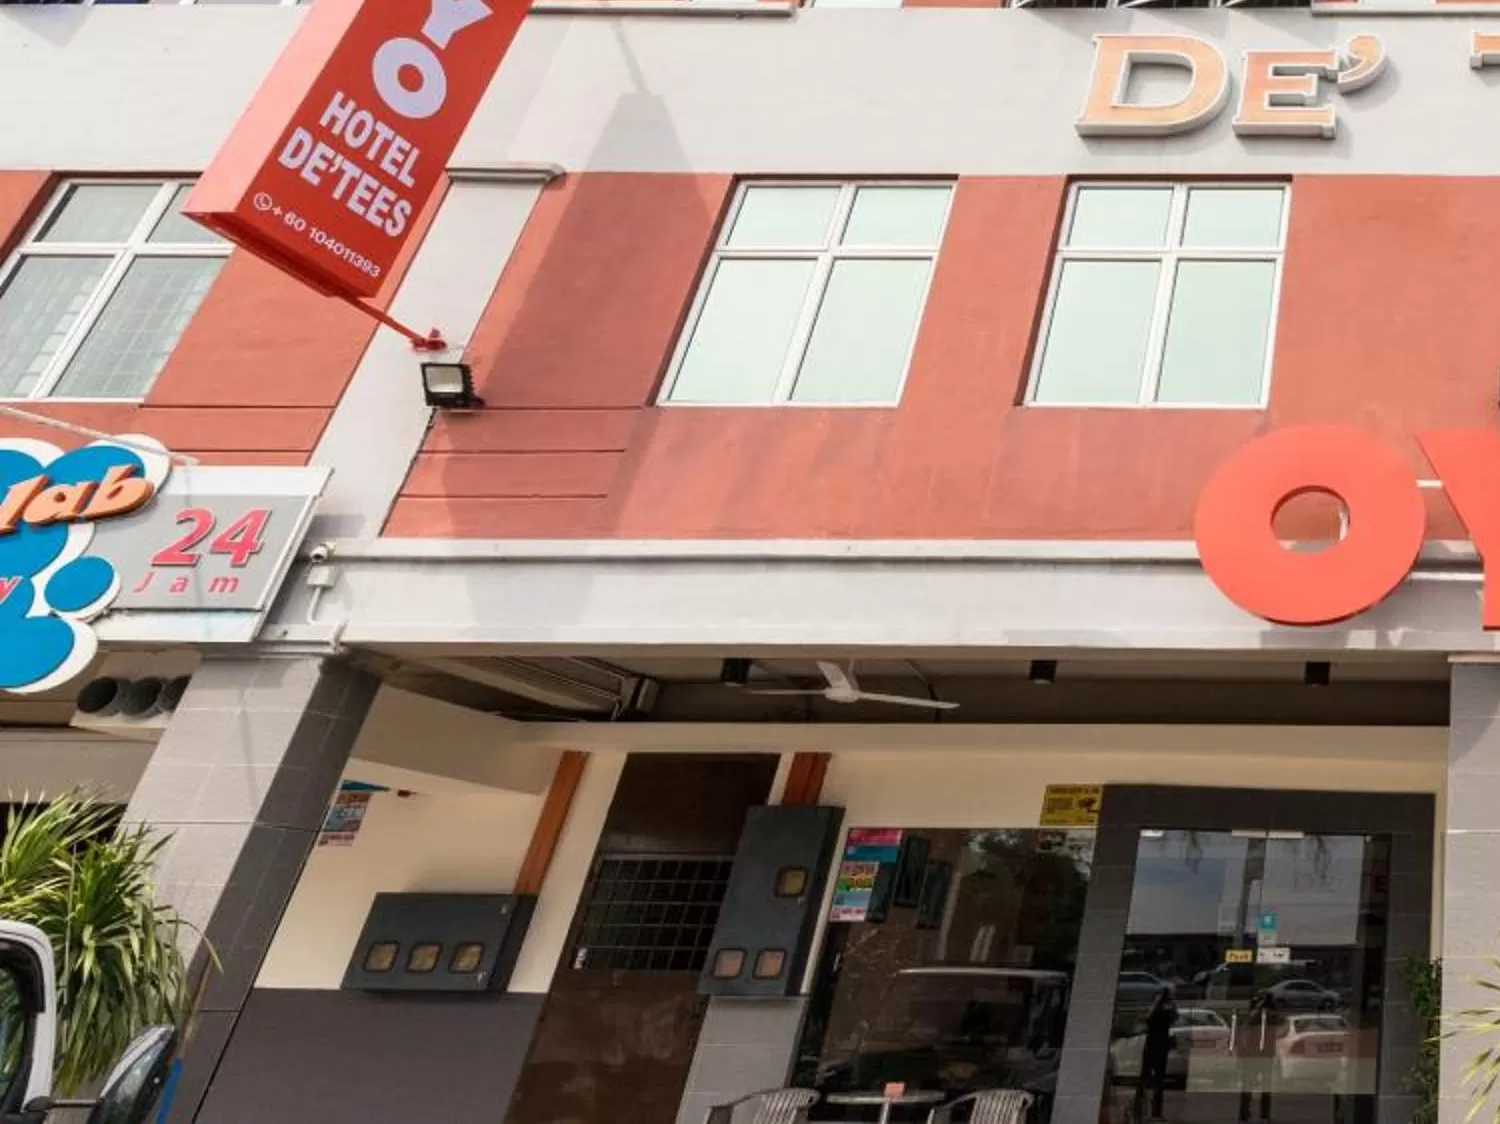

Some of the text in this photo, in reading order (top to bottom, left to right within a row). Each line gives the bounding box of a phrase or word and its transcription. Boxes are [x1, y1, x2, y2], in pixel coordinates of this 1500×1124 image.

[319, 90, 421, 189] HOTEL
[277, 125, 412, 237] DE'TEES
[151, 507, 274, 569] 24
[132, 571, 240, 594] Jam
